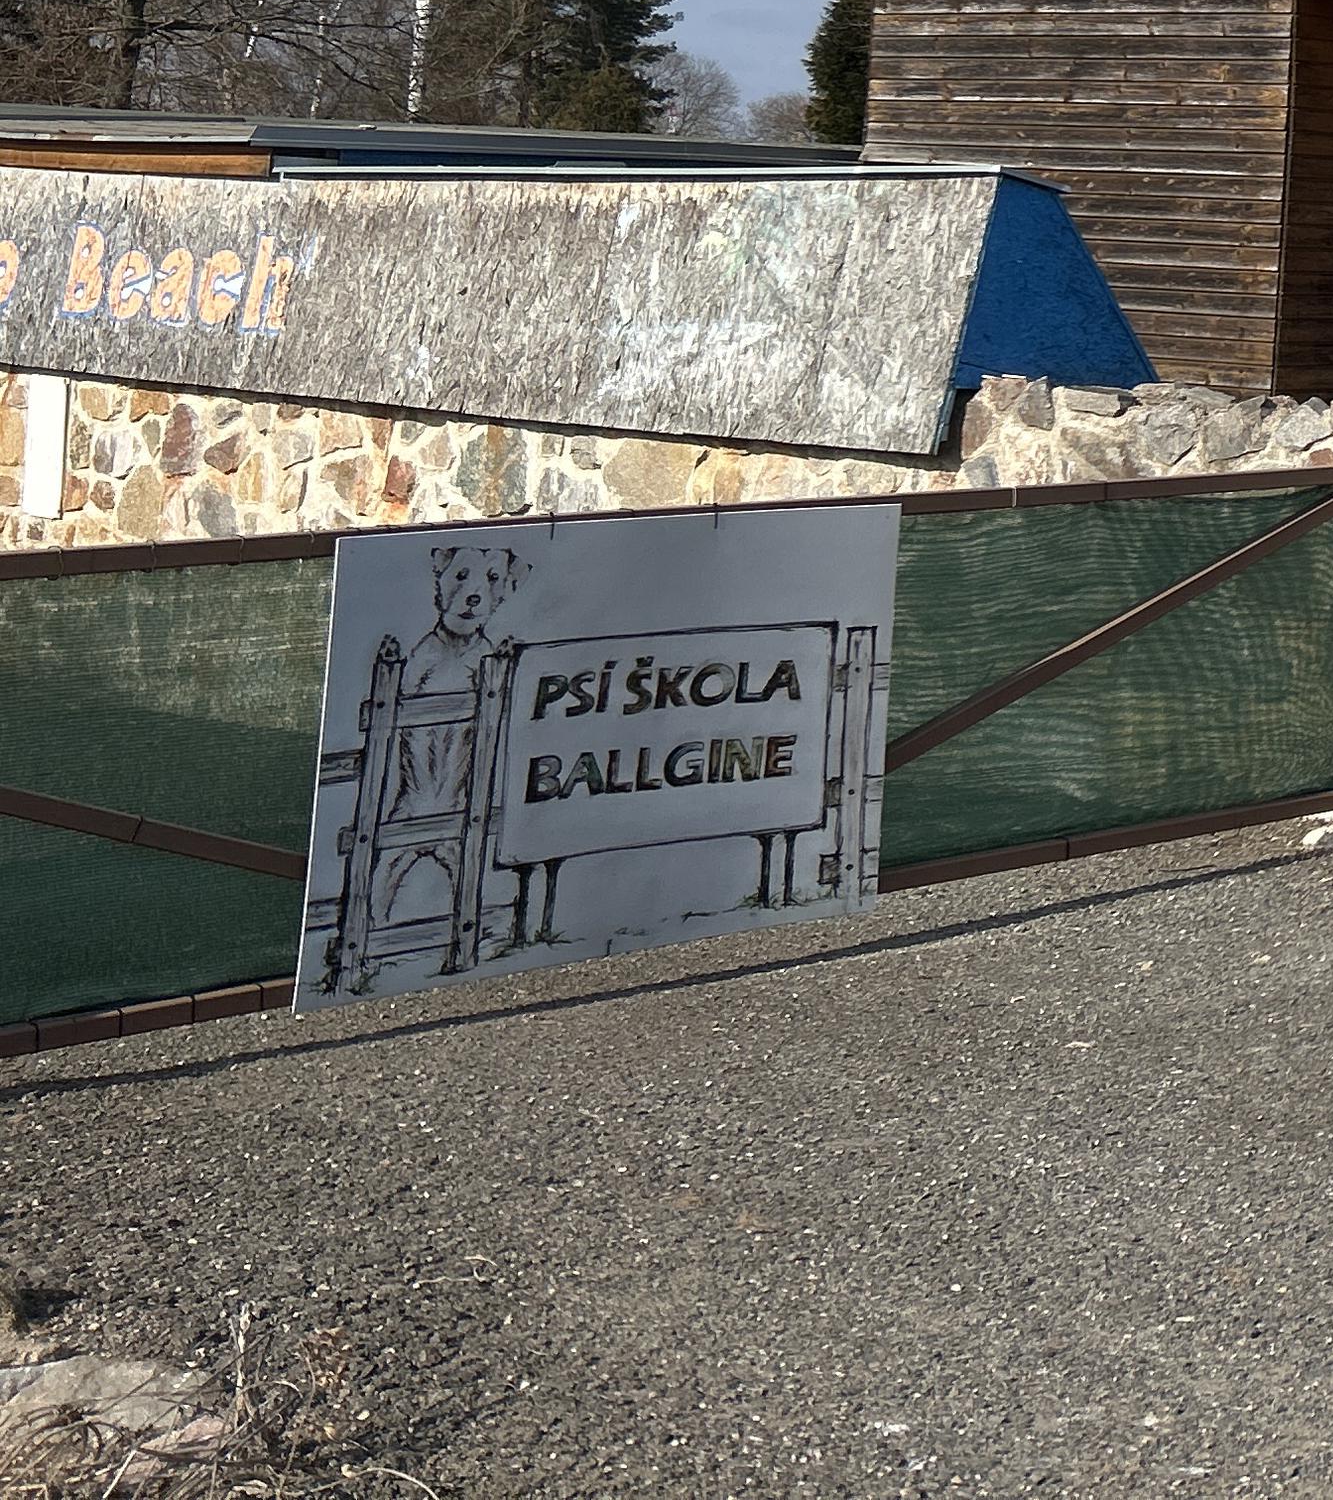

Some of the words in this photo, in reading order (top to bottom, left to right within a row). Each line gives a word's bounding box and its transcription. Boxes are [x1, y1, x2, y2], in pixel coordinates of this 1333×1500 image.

[57, 218, 296, 336] Beach
[530, 660, 618, 721] PSÍ
[623, 656, 801, 715] ŠKOLA
[524, 734, 798, 804] BALLGINE
